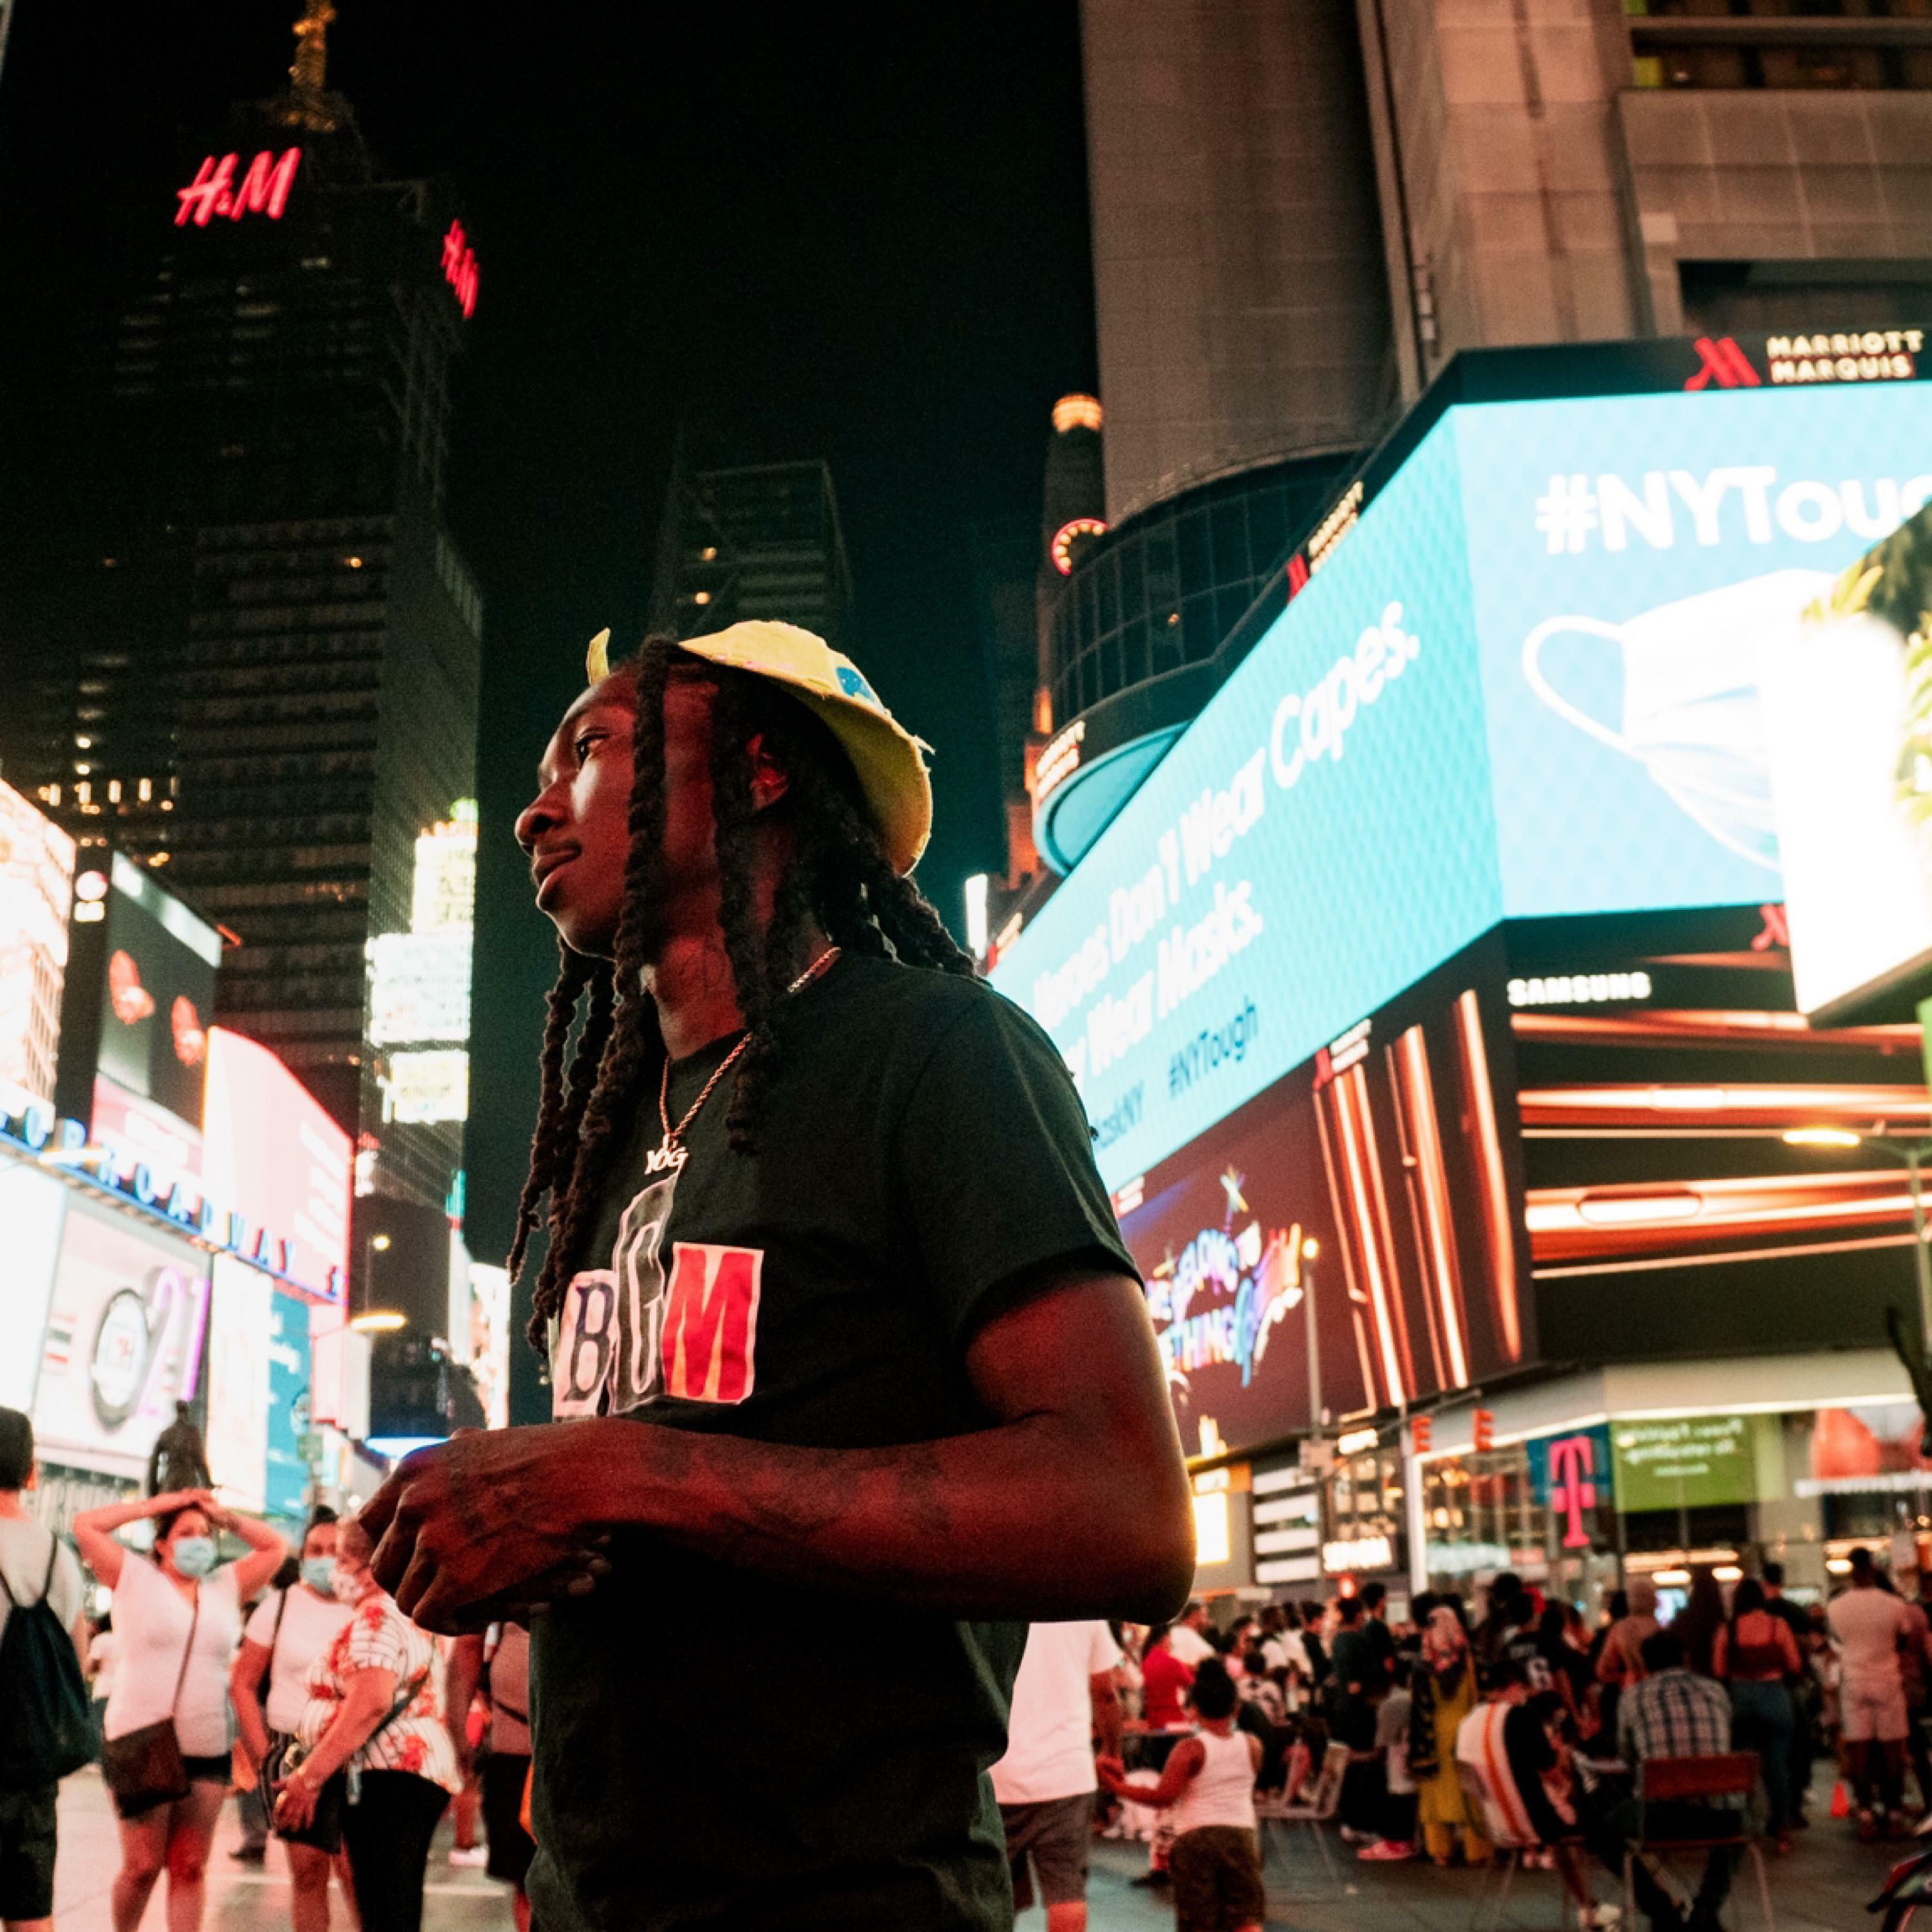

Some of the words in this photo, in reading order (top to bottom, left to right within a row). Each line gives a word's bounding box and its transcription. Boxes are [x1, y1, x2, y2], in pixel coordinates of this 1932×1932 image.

[175, 147, 301, 227] H&M
[1766, 330, 1923, 358] MARRIOTT
[1771, 355, 1912, 383] MARQUIS
[1535, 466, 1932, 555] #NYTou
[1507, 971, 1651, 1007] SAMSUNG
